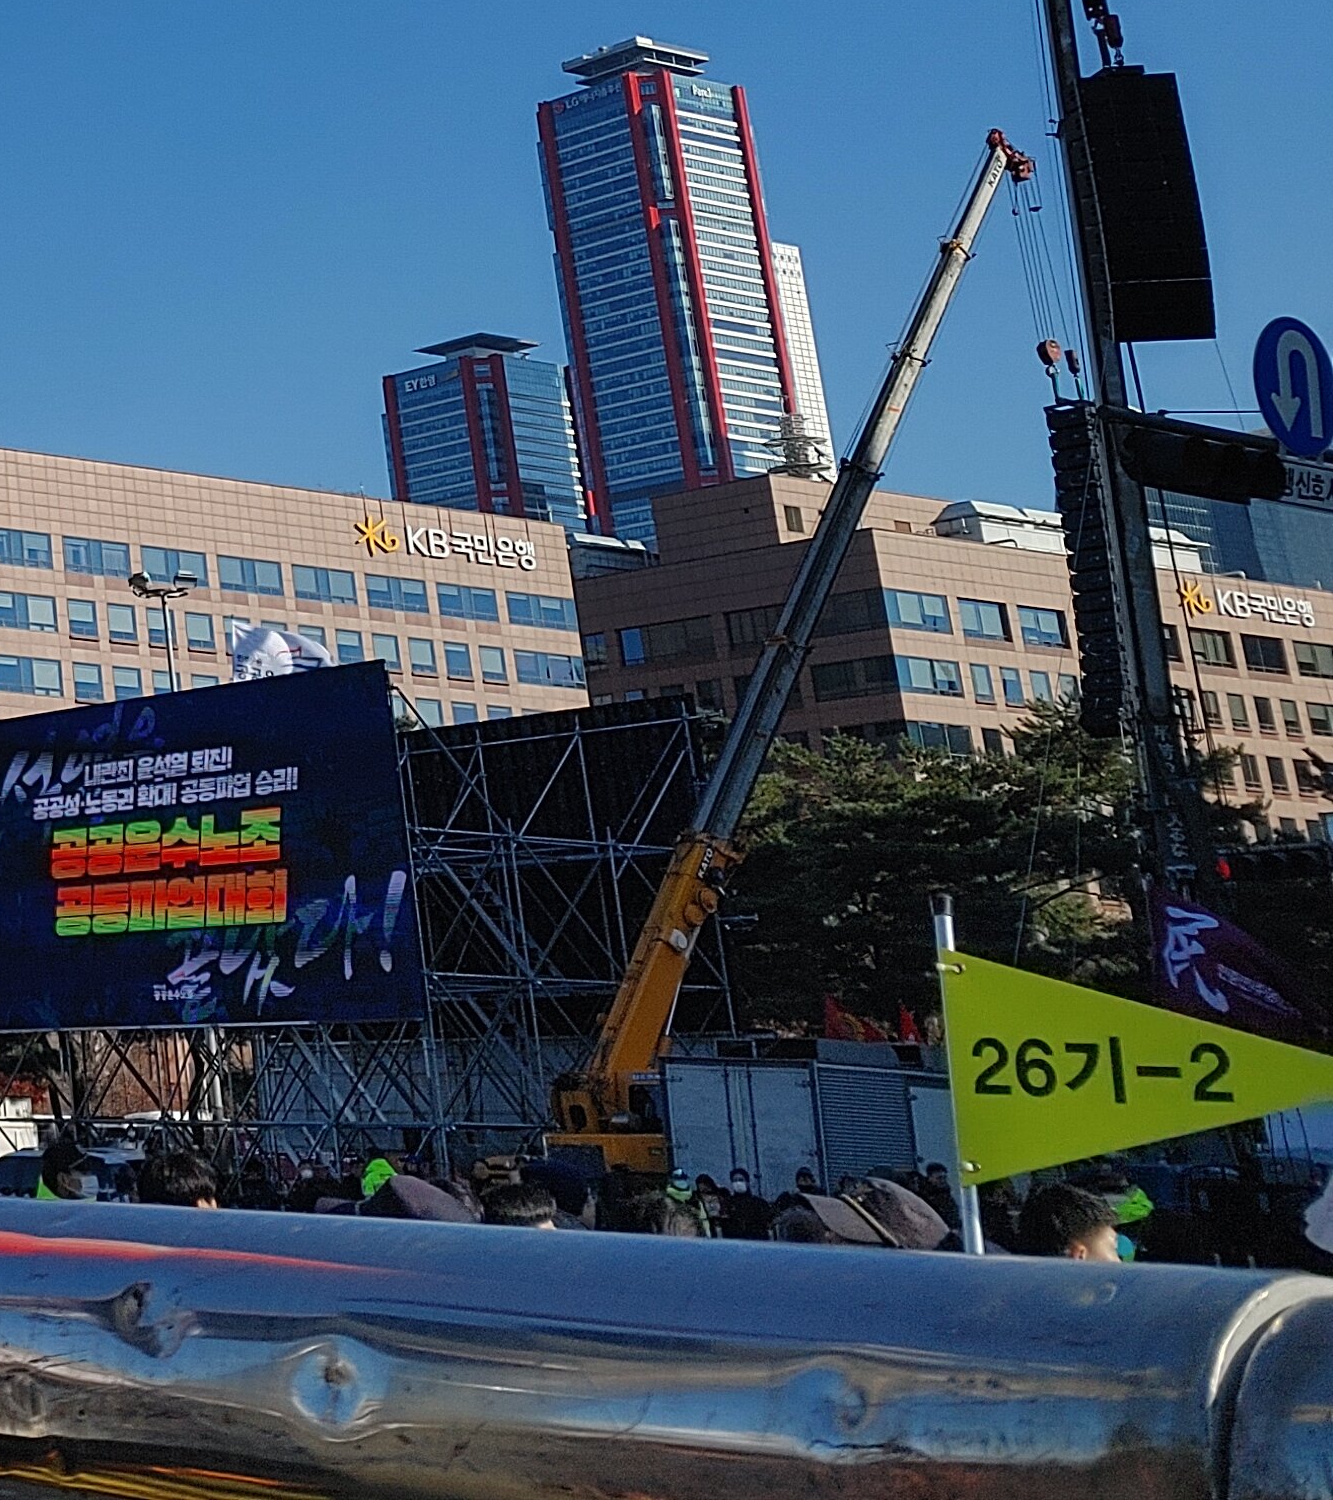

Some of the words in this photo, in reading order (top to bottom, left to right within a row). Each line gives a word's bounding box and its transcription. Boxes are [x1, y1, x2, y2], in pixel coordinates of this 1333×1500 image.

[405, 525, 537, 571] KB국민은행
[1217, 588, 1316, 628] KB국민은행
[84, 759, 133, 787] 내란죄
[137, 752, 188, 780] 윤석열
[191, 746, 233, 773] 퇴진!
[137, 781, 177, 808] 확대!
[181, 772, 251, 804] 공동파업
[255, 766, 298, 796] 승리!
[50, 806, 281, 879] 공공운수노조
[54, 868, 289, 937] 공동파업대회
[971, 1035, 1235, 1105] 26기-2
